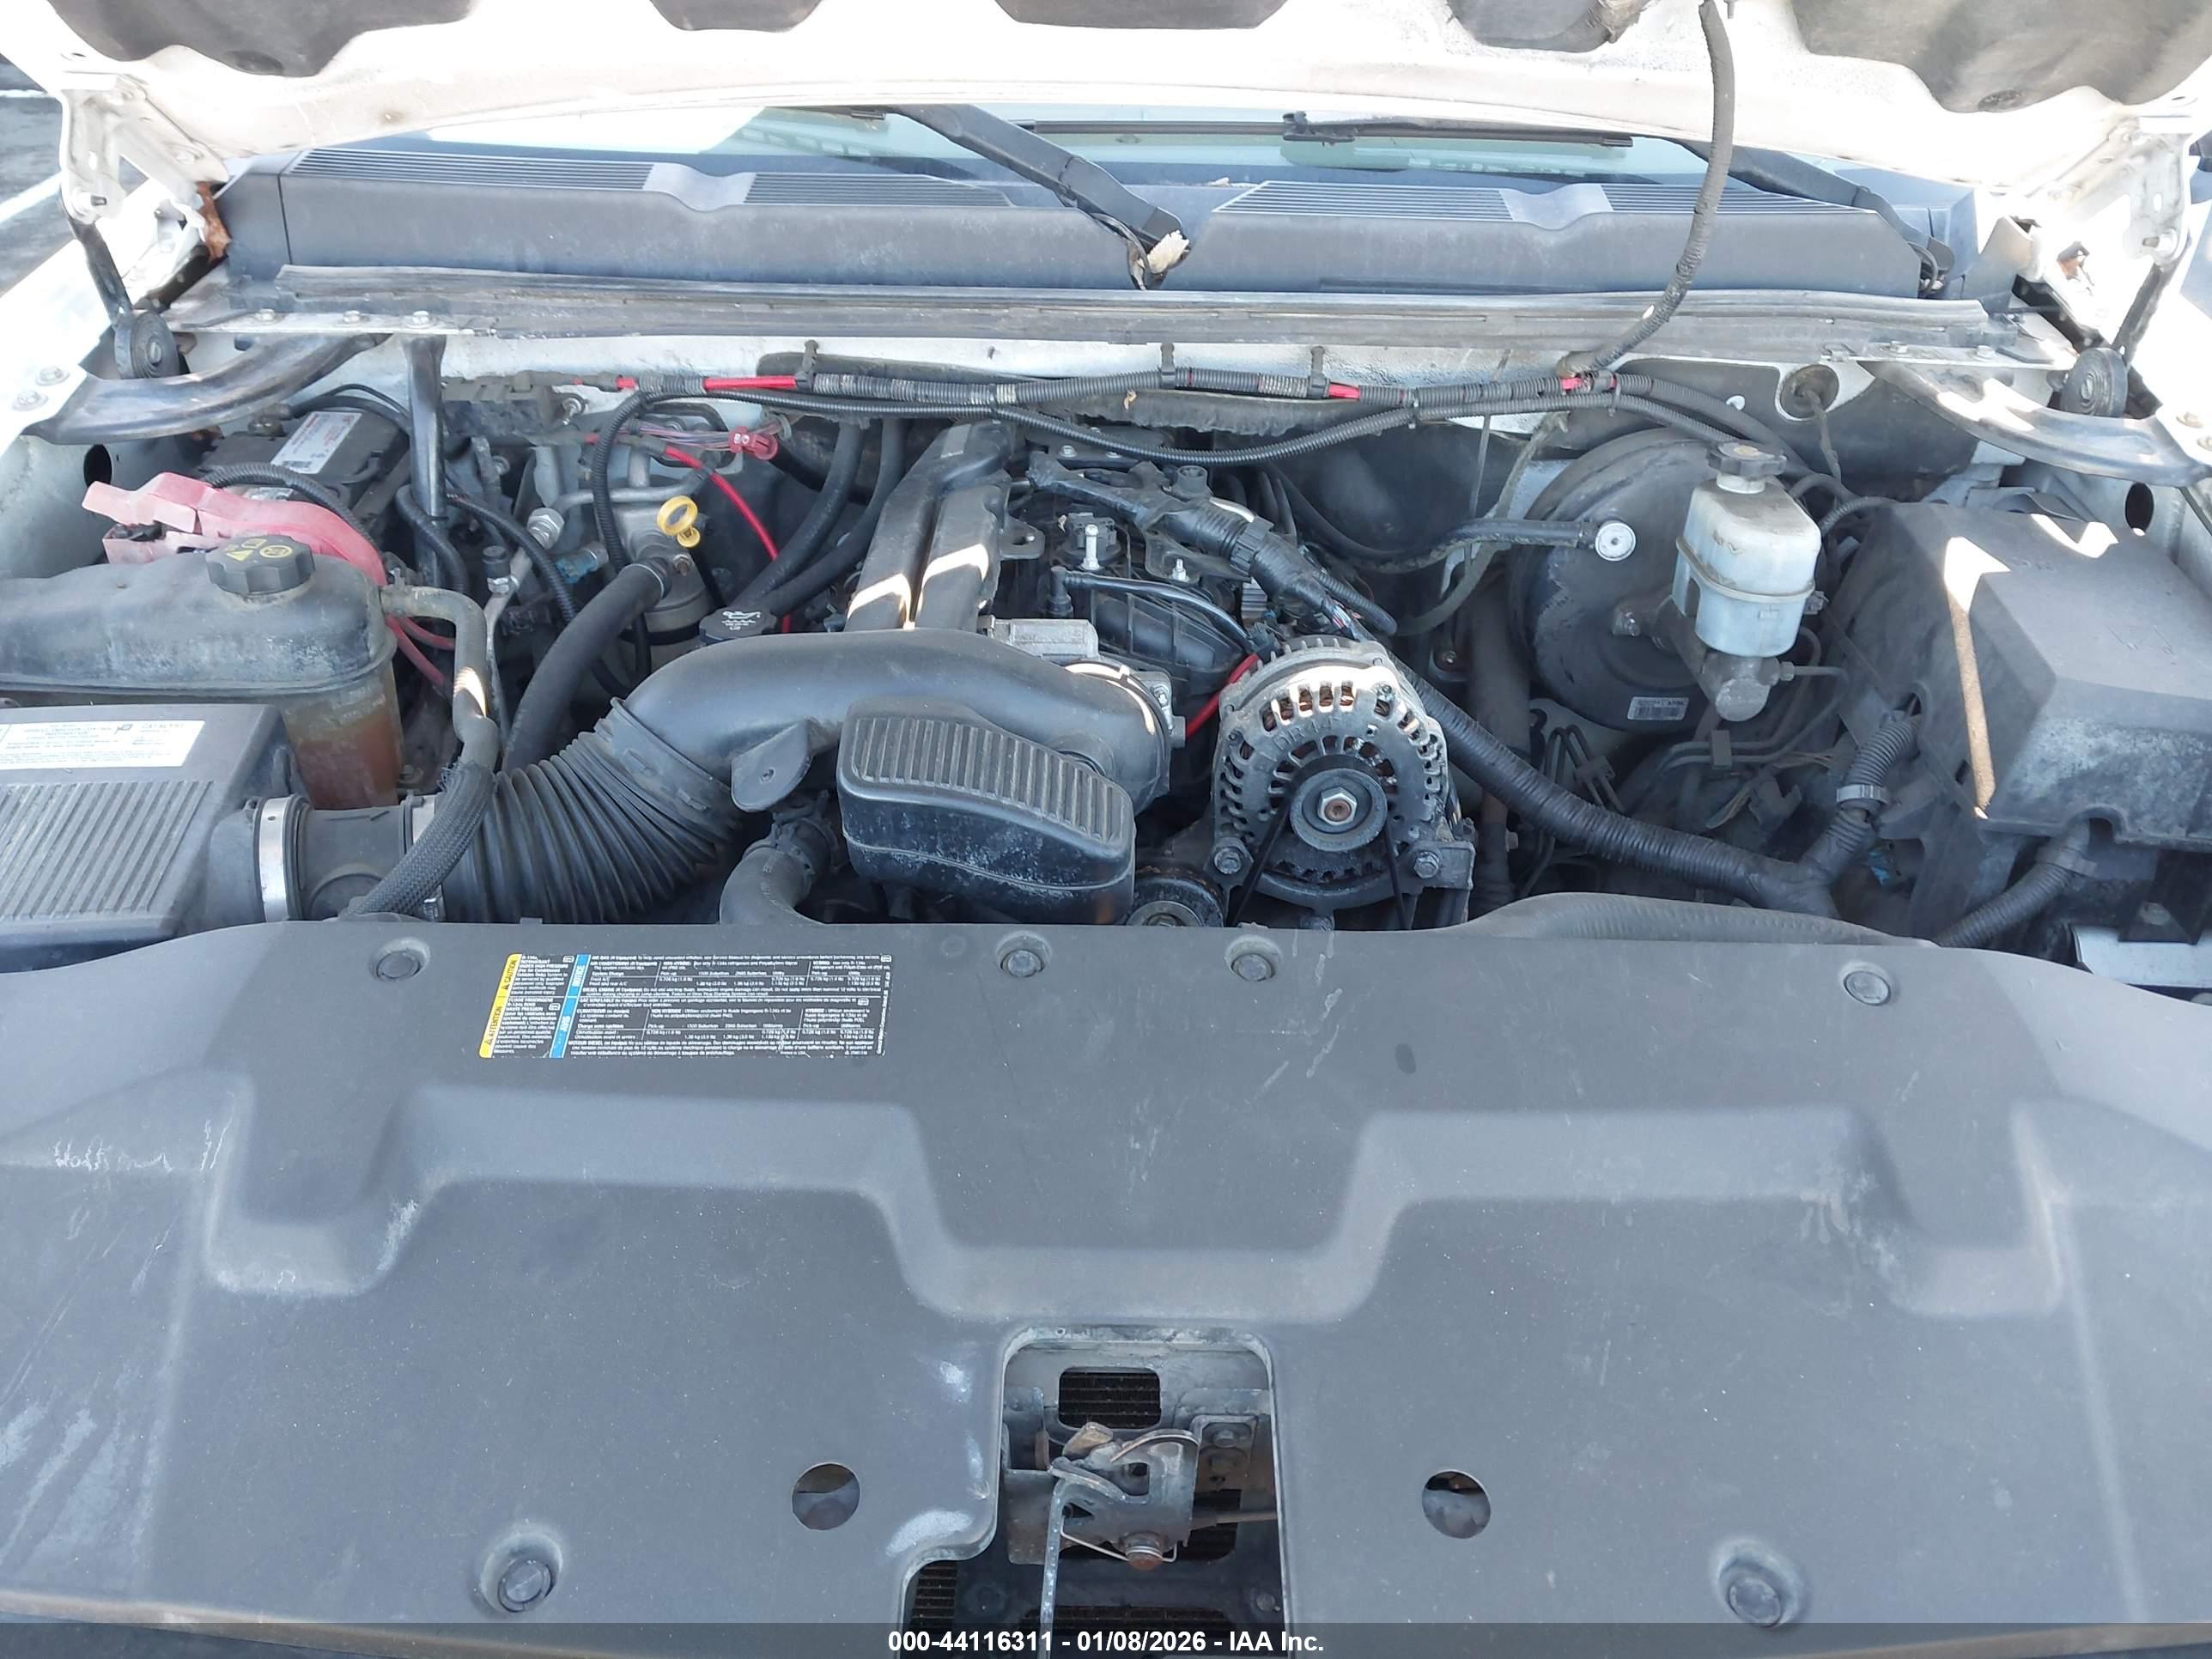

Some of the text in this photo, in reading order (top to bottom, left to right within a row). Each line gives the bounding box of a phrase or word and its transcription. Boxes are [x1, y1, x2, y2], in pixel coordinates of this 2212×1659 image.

[505, 959, 517, 985] CAUTION
[572, 964, 585, 987] NOTICE
[489, 1006, 502, 1037] ATTENTION
